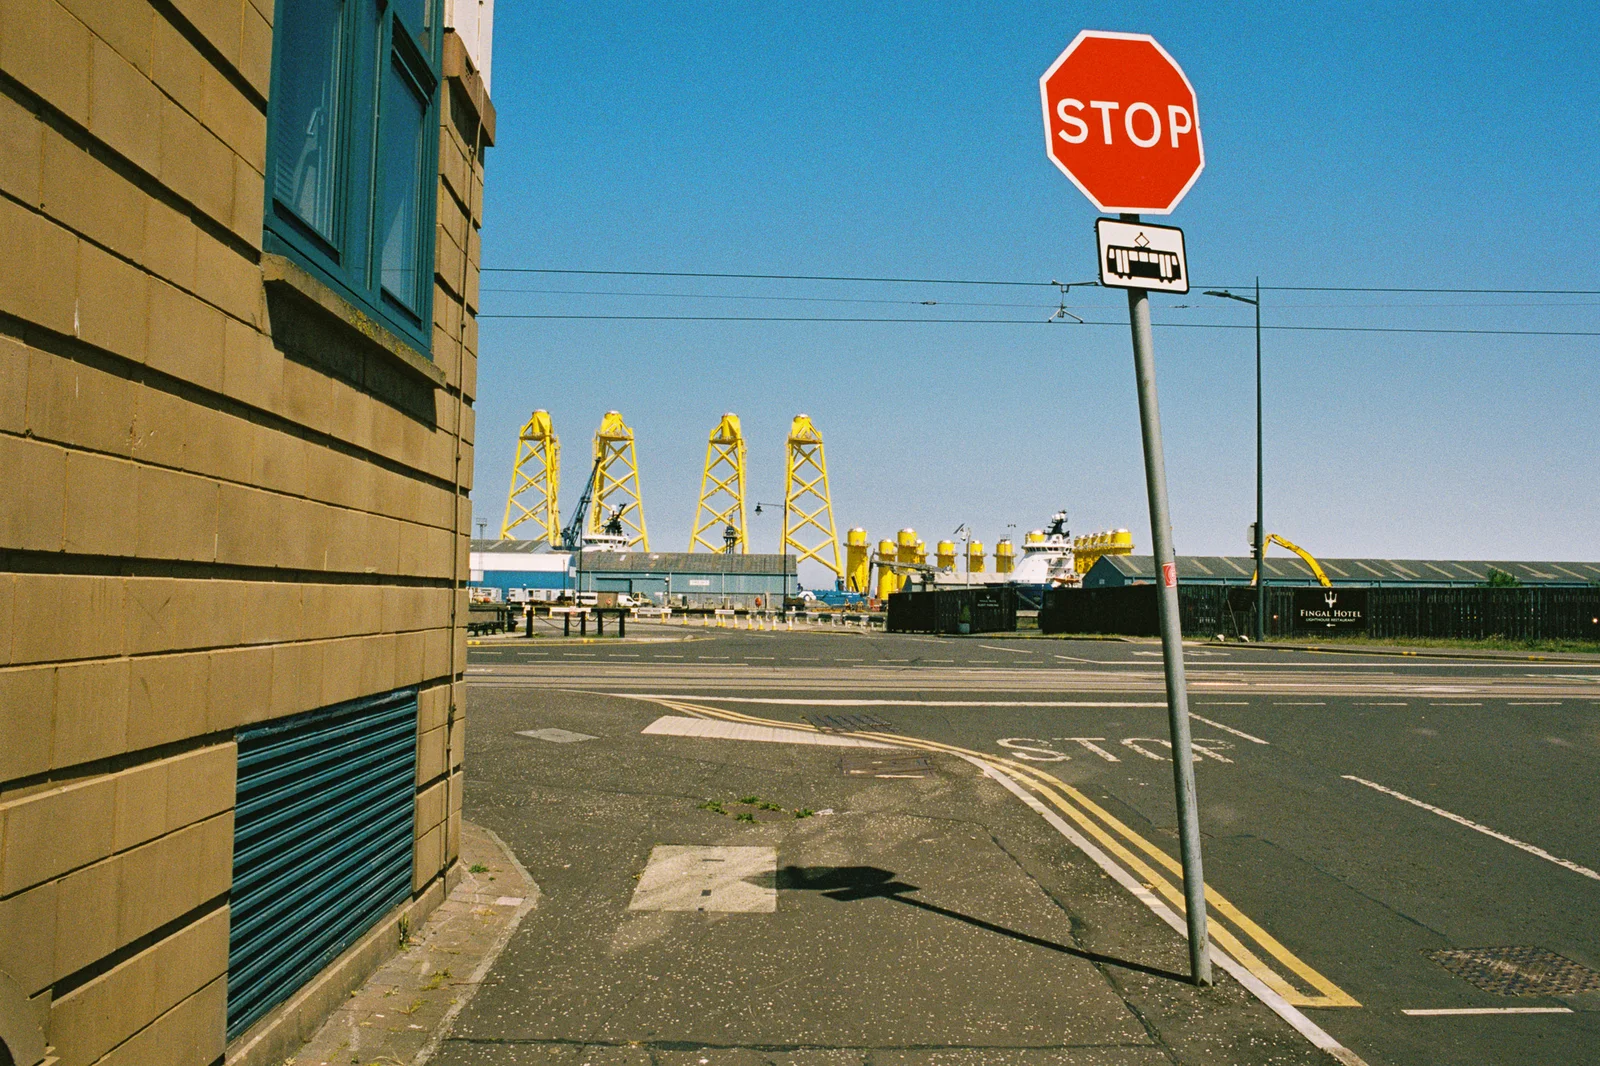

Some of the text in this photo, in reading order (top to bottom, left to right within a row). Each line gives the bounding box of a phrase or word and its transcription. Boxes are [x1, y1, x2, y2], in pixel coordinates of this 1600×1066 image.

[1056, 98, 1192, 148] STOP
[1300, 609, 1362, 617] FINGAL HOTEL
[996, 737, 1236, 764] STOP
